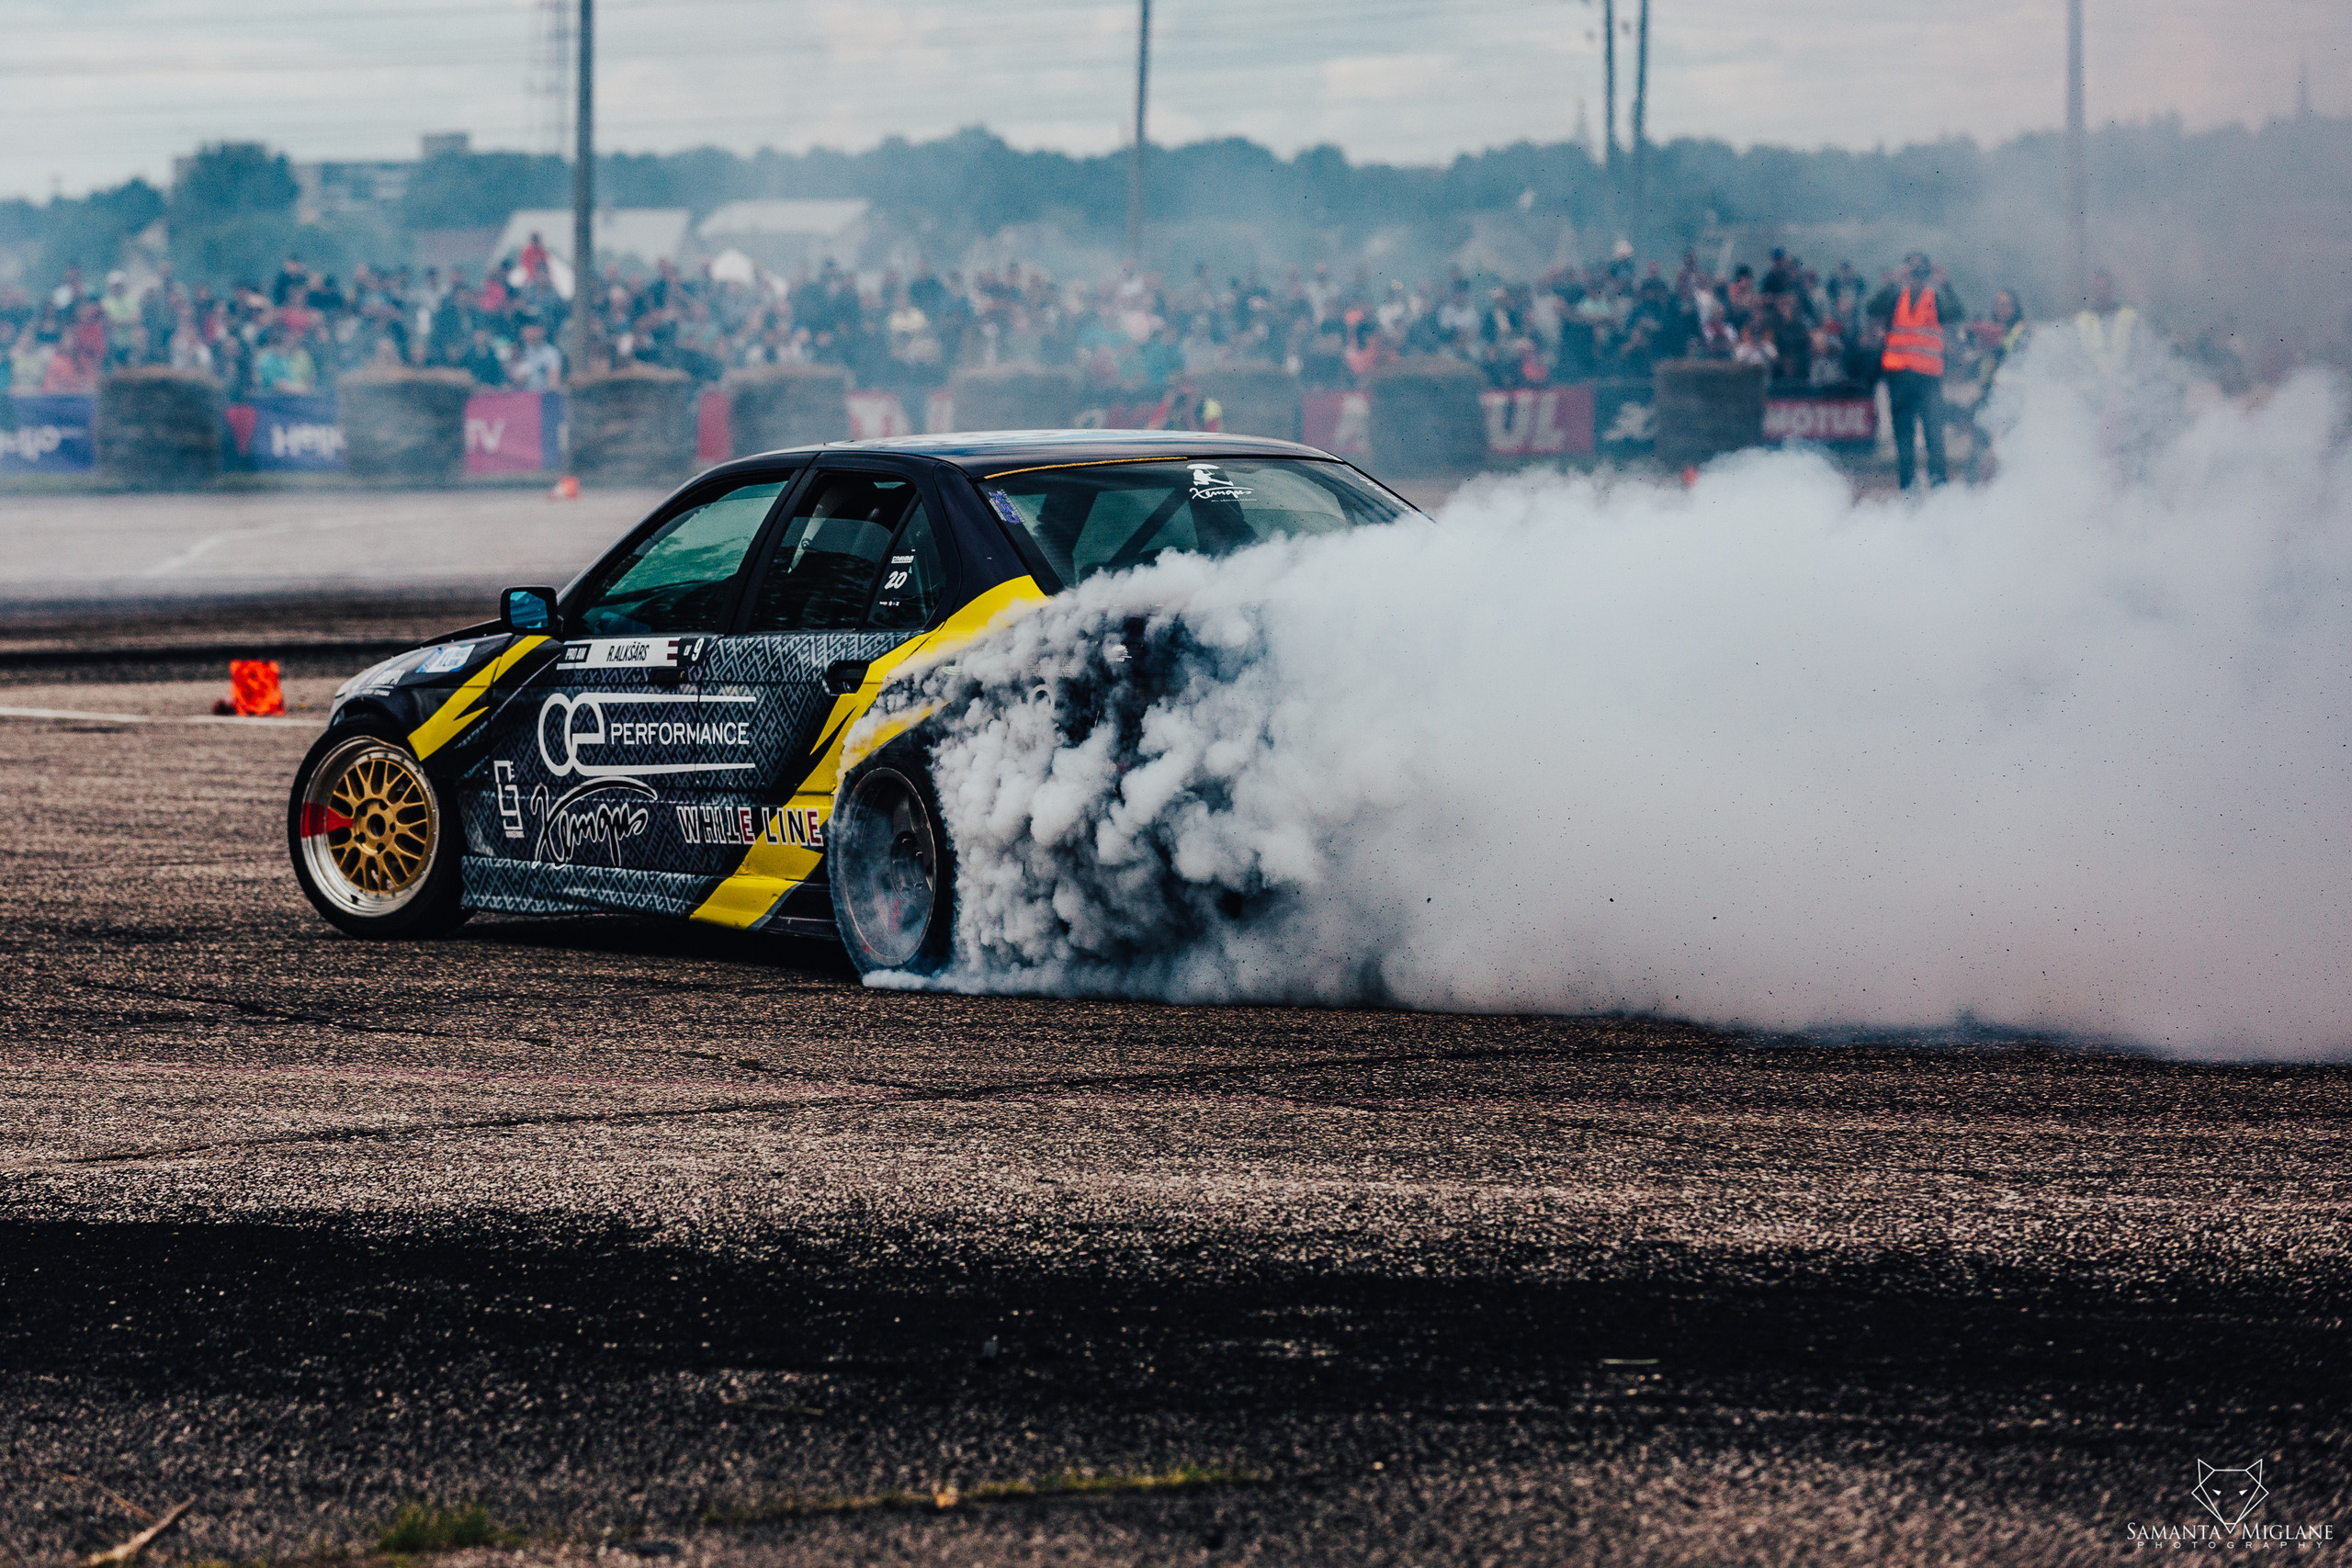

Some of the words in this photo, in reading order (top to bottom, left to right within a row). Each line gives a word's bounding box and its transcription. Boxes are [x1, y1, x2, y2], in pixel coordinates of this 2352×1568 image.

[611, 722, 750, 746] PERFORMANCE
[676, 806, 756, 845] WHITE
[762, 807, 824, 846] LINE
